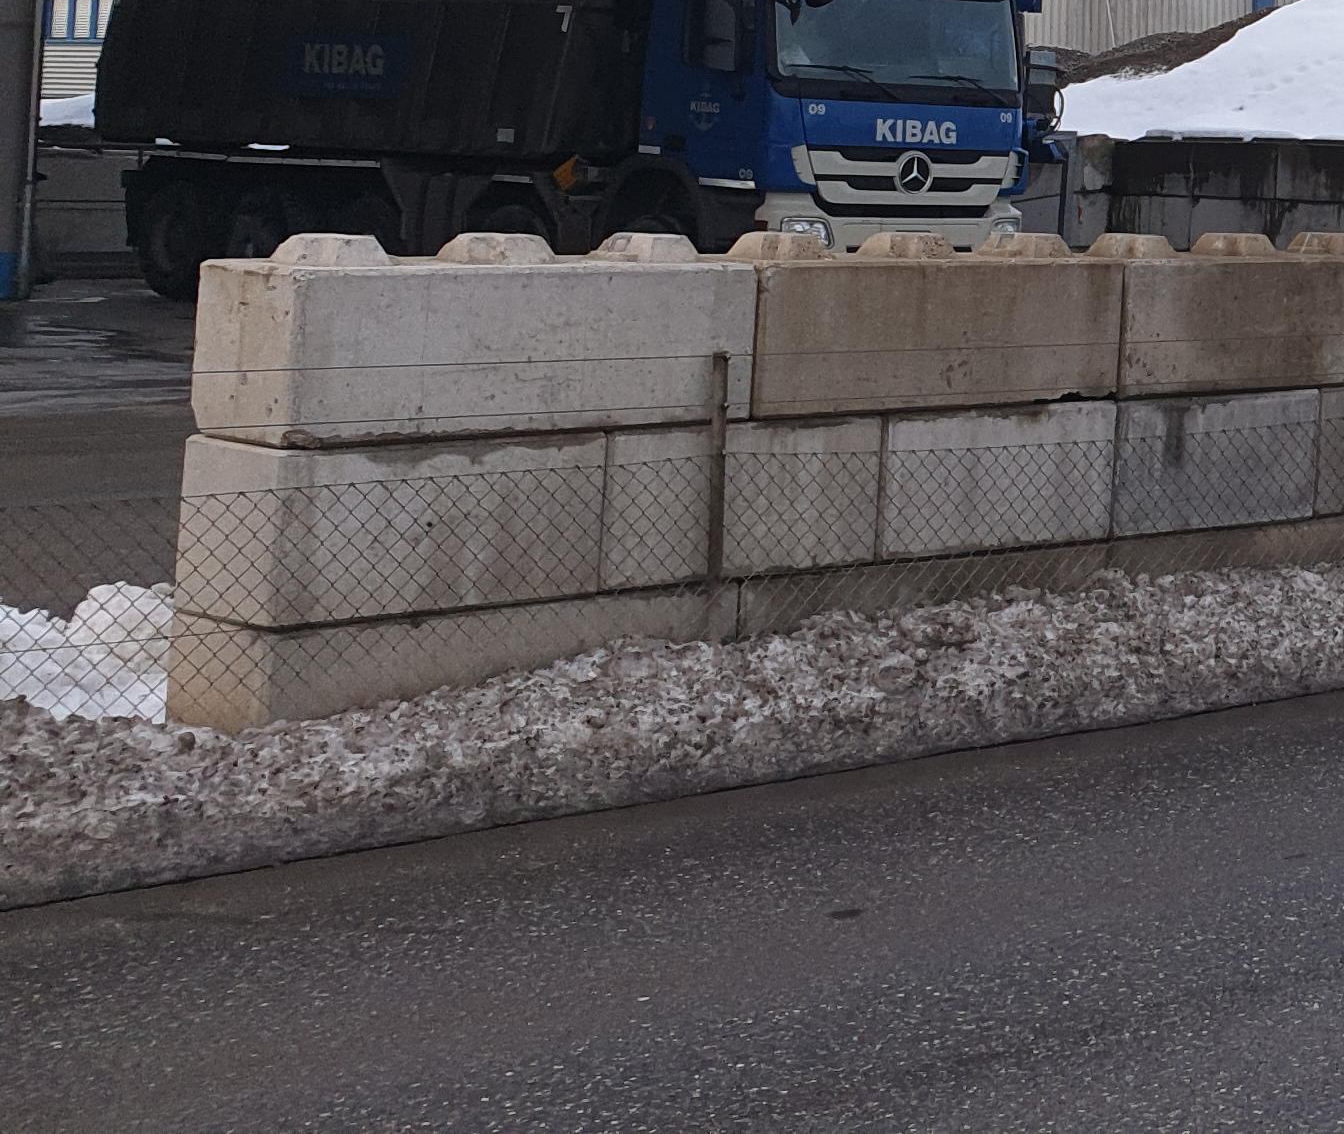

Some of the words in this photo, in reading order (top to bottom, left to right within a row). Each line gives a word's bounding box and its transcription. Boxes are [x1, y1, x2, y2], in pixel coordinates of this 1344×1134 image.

[556, 5, 573, 33] 7
[302, 41, 385, 76] KIBAG
[808, 103, 826, 115] 09
[1000, 112, 1013, 123] 09
[875, 117, 958, 145] KIBAG
